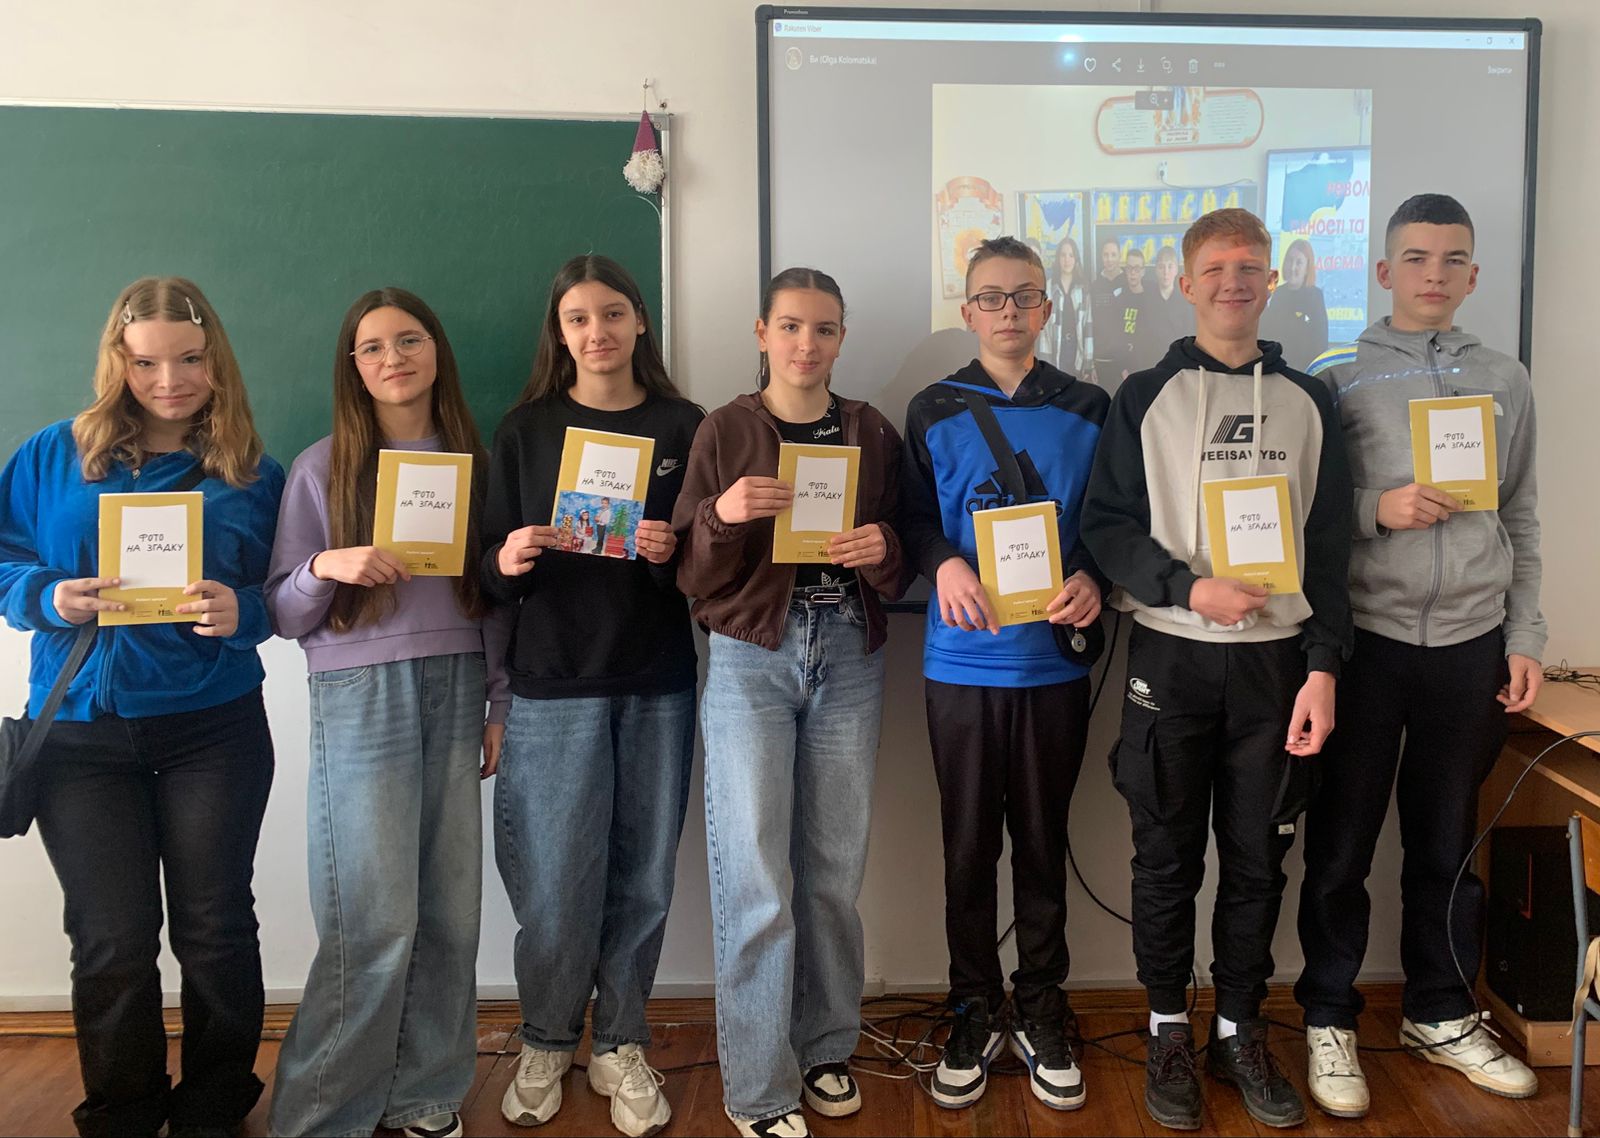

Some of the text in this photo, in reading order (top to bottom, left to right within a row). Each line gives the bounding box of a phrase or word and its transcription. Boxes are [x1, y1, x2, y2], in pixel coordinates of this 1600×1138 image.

[1444, 432, 1465, 441] ФОТО
[1434, 441, 1481, 451] НА ЗГАДКУ
[594, 469, 616, 479] ФОТО
[600, 480, 632, 491] ЗГАДКУ
[808, 482, 828, 490] ФОТО
[412, 490, 435, 499] ФОТО
[798, 491, 842, 500] НА ЗГАДКУ
[400, 500, 453, 510] НА ЗГАДКУ
[1239, 514, 1261, 522] ФОТО
[1247, 522, 1279, 531] ЗГАДКУ
[138, 533, 164, 543] ФОТО
[126, 543, 184, 552] НА ЗГАДКУ
[1008, 543, 1030, 553] ФОТО
[1016, 550, 1046, 561] ЗГАДКУ
